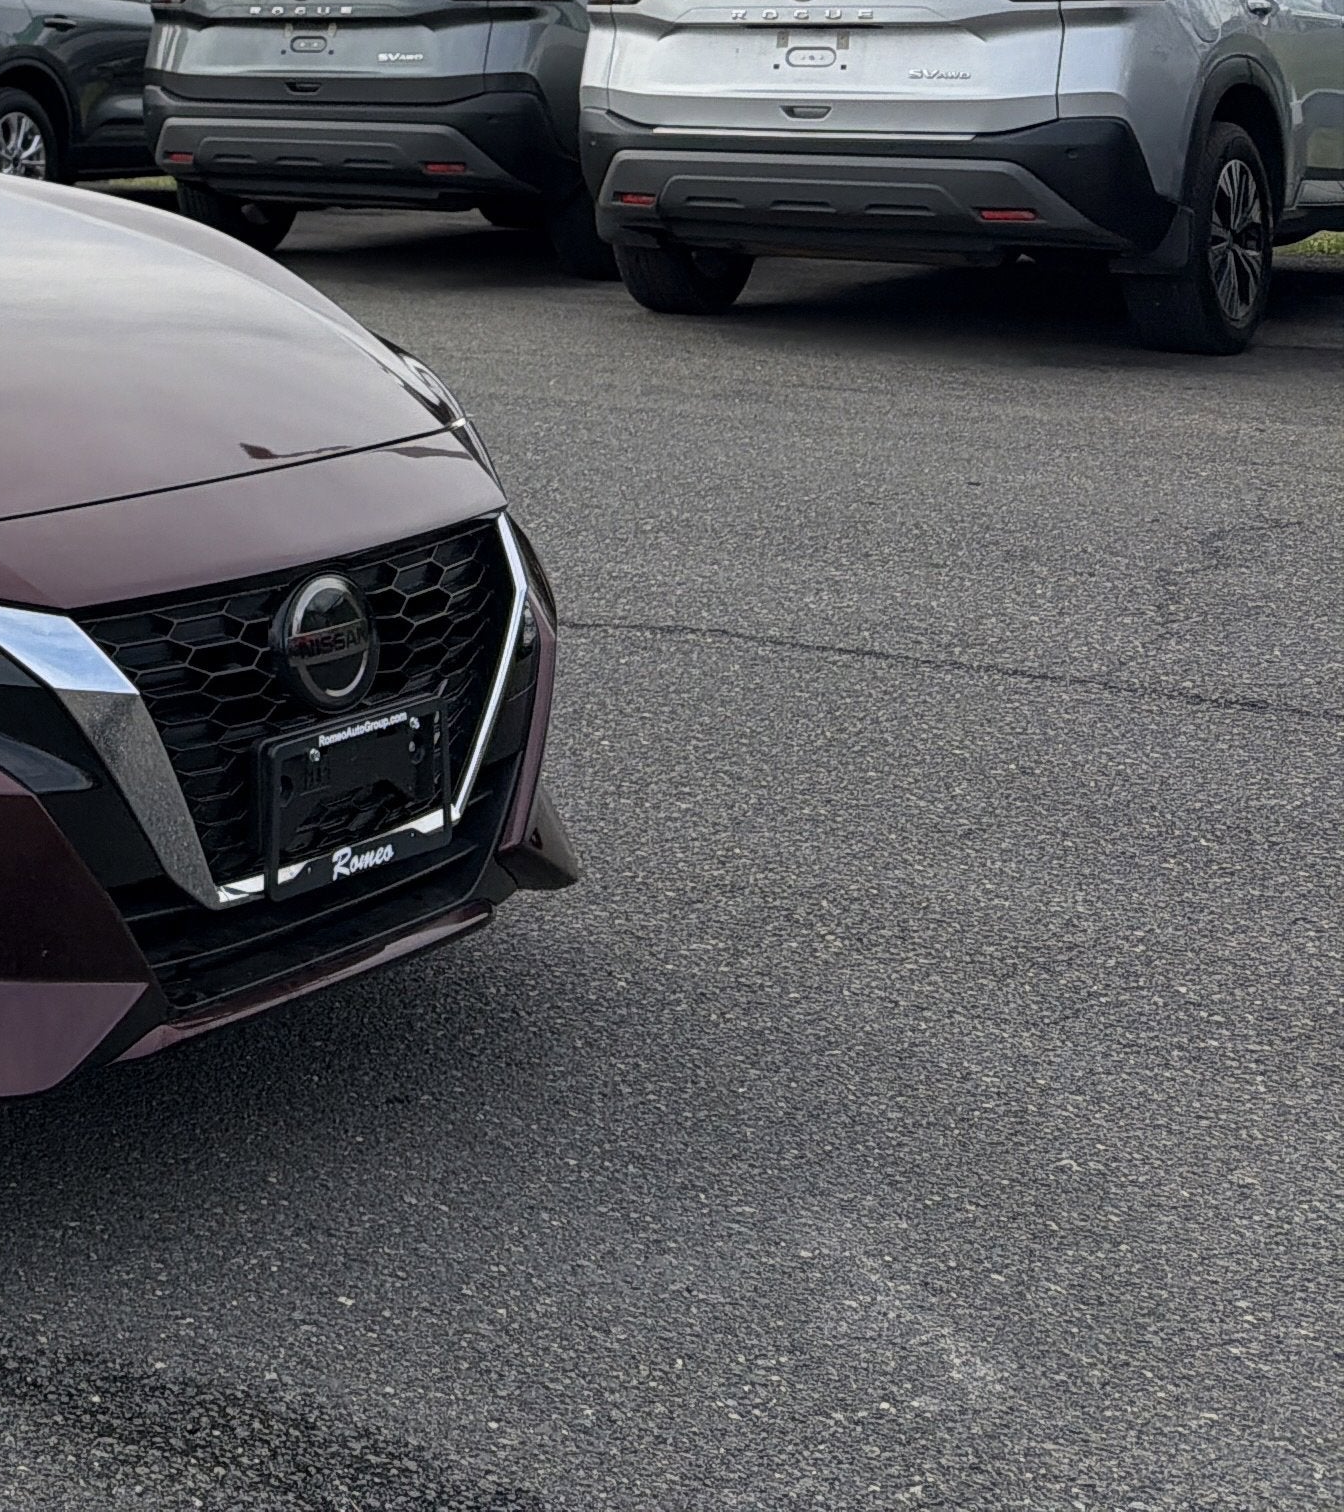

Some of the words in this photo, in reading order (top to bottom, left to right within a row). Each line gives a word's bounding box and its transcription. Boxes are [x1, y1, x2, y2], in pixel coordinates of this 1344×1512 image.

[249, 6, 352, 16] ROGUE
[731, 8, 874, 20] ROGUE
[298, 624, 365, 658] NISSAN
[318, 711, 408, 748] RomeoAutoGroup.com
[332, 844, 395, 881] Romeo
